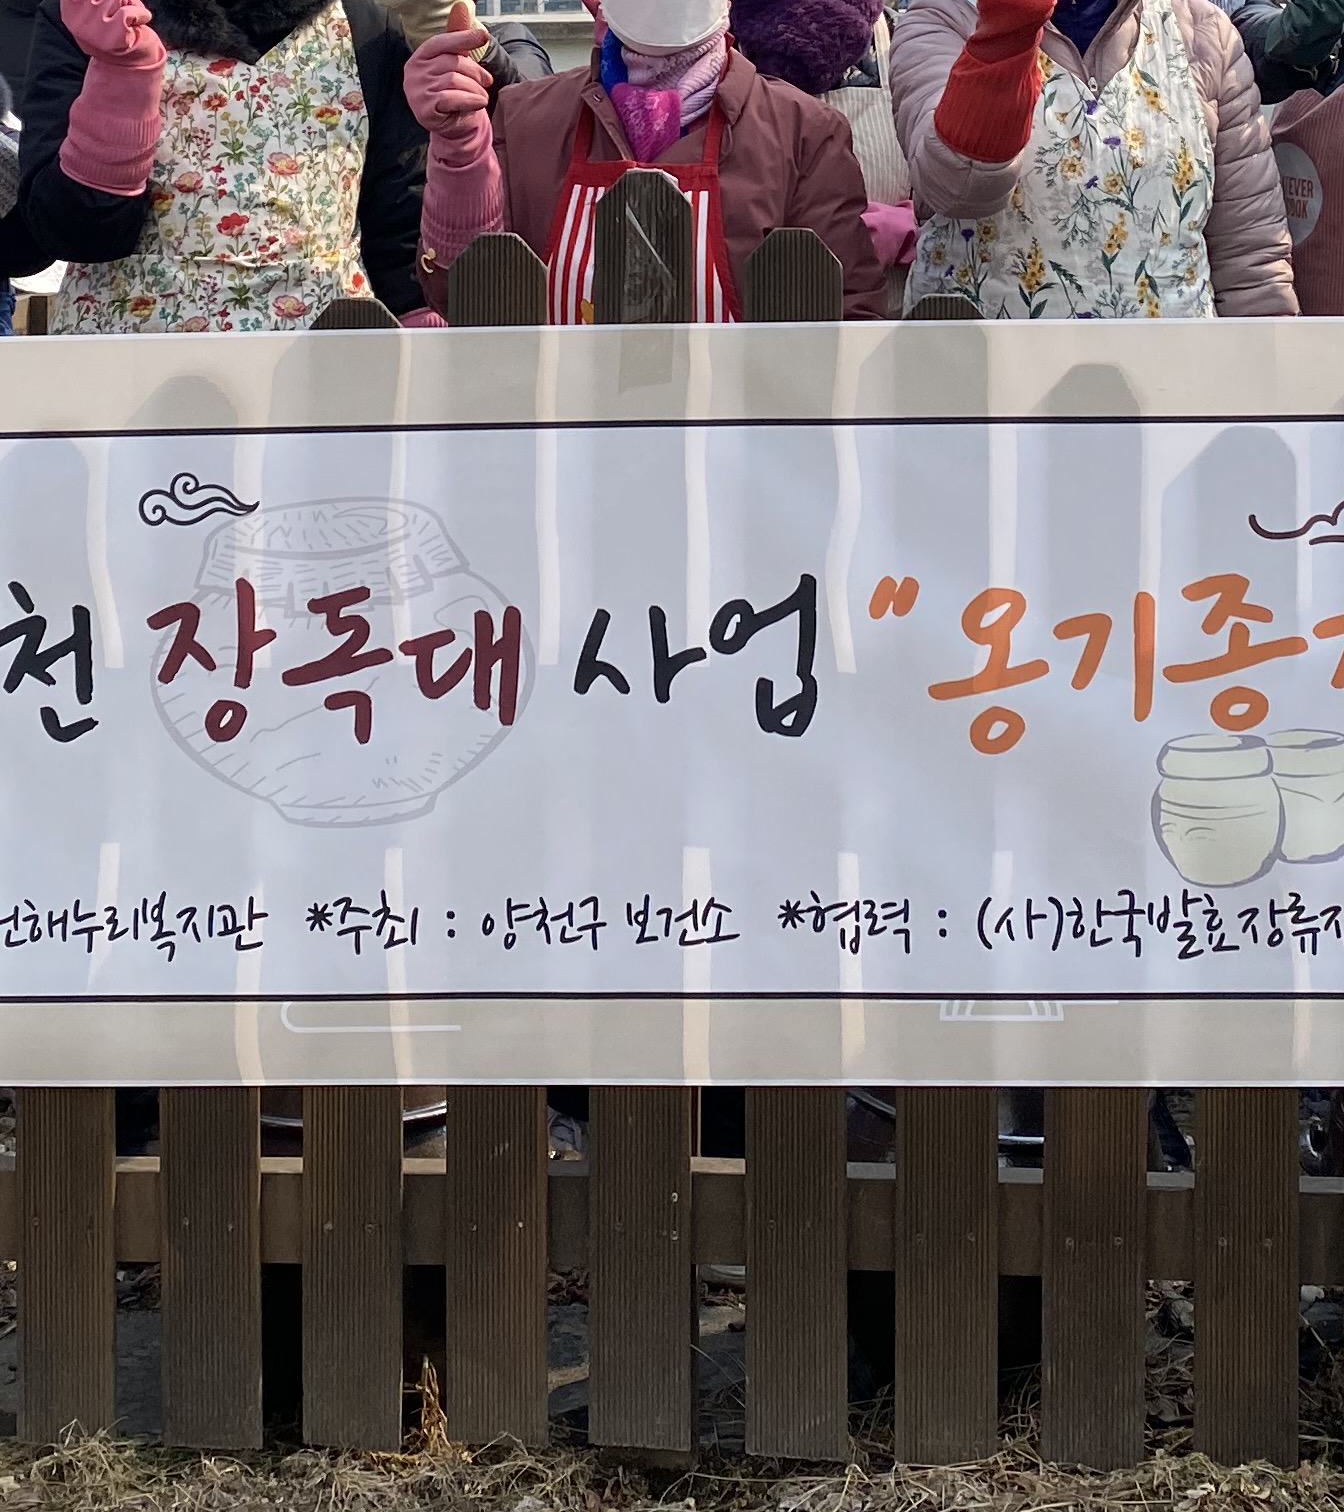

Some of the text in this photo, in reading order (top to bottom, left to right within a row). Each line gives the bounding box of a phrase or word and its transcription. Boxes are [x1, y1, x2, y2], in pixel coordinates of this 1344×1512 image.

[148, 578, 522, 744] 장독대
[573, 573, 818, 738] 사업
[481, 895, 608, 951] 양천구
[626, 893, 741, 947] 보건소
